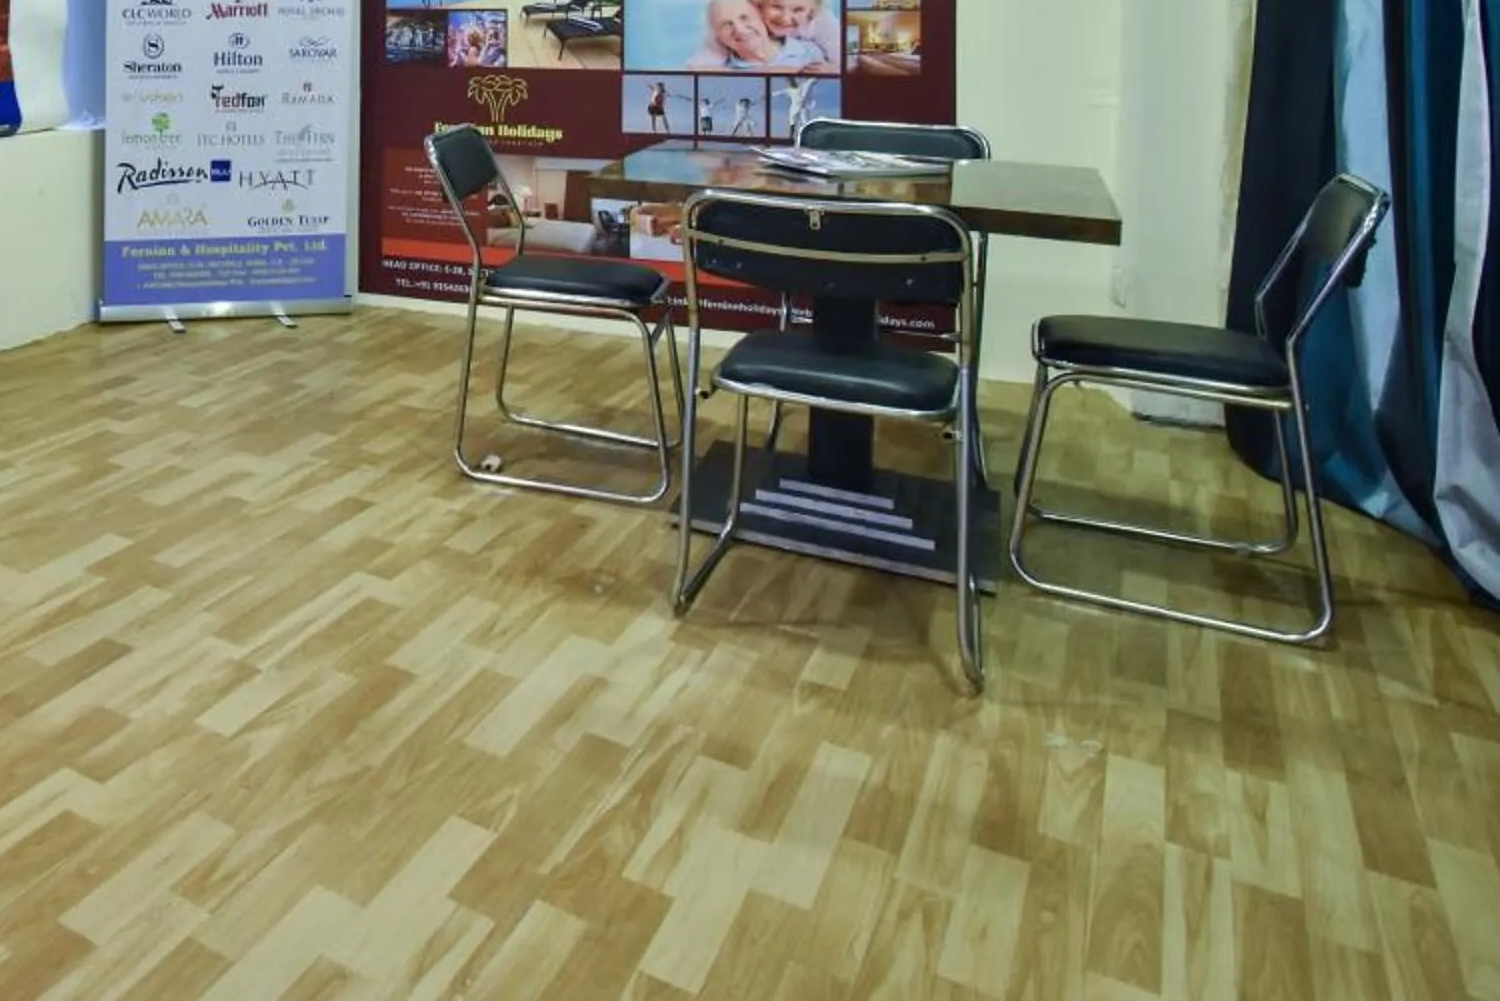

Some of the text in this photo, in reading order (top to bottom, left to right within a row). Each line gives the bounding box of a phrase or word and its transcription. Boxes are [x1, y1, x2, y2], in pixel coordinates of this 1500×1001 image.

[205, 2, 269, 20] Marriott
[123, 61, 182, 74] Sheraton
[213, 52, 263, 66] Hilton
[498, 124, 563, 143] Holidays
[117, 157, 209, 194] Radisson
[239, 168, 317, 191] HYATT
[137, 208, 209, 229] AMARA
[247, 215, 293, 228] GOLDEN
[195, 242, 269, 257] Hospitality
